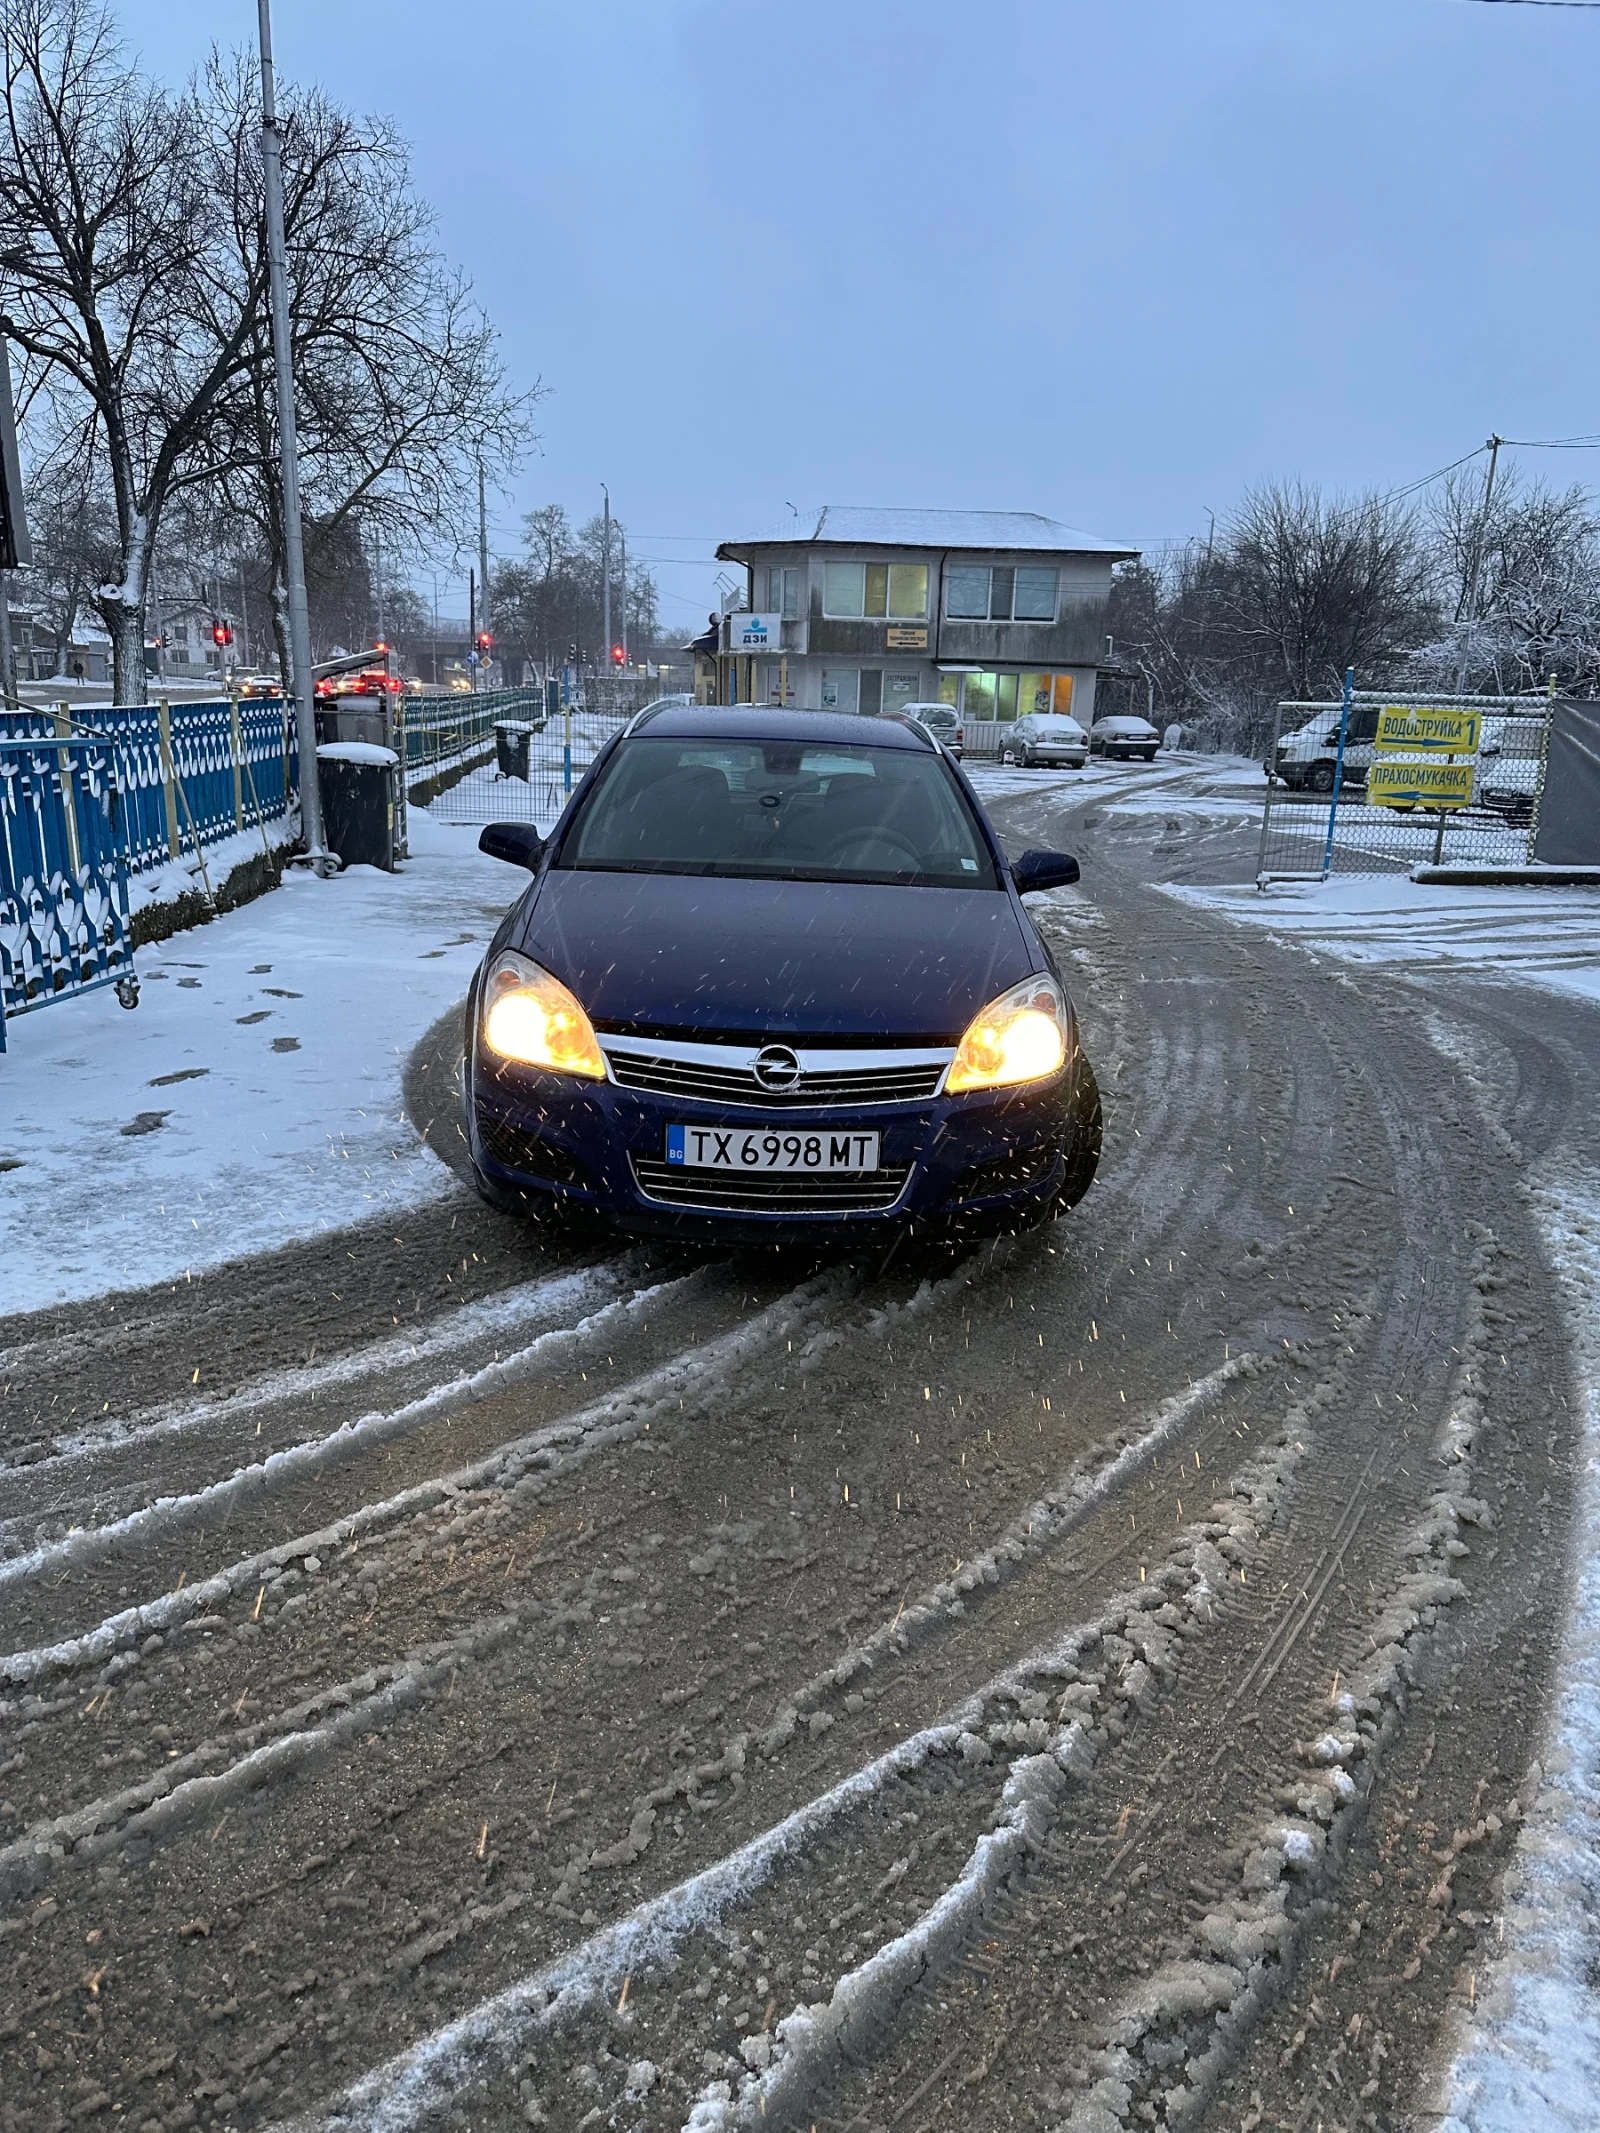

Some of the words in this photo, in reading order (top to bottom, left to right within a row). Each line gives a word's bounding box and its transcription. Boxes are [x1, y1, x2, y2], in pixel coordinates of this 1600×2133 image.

[743, 634, 768, 644] ДЗИ
[1383, 717, 1462, 738] ВОДОСТРУЙКА
[1466, 720, 1476, 746] 1
[1374, 768, 1467, 786] ПРАХОСМУКАЧКА
[669, 1150, 683, 1159] BG
